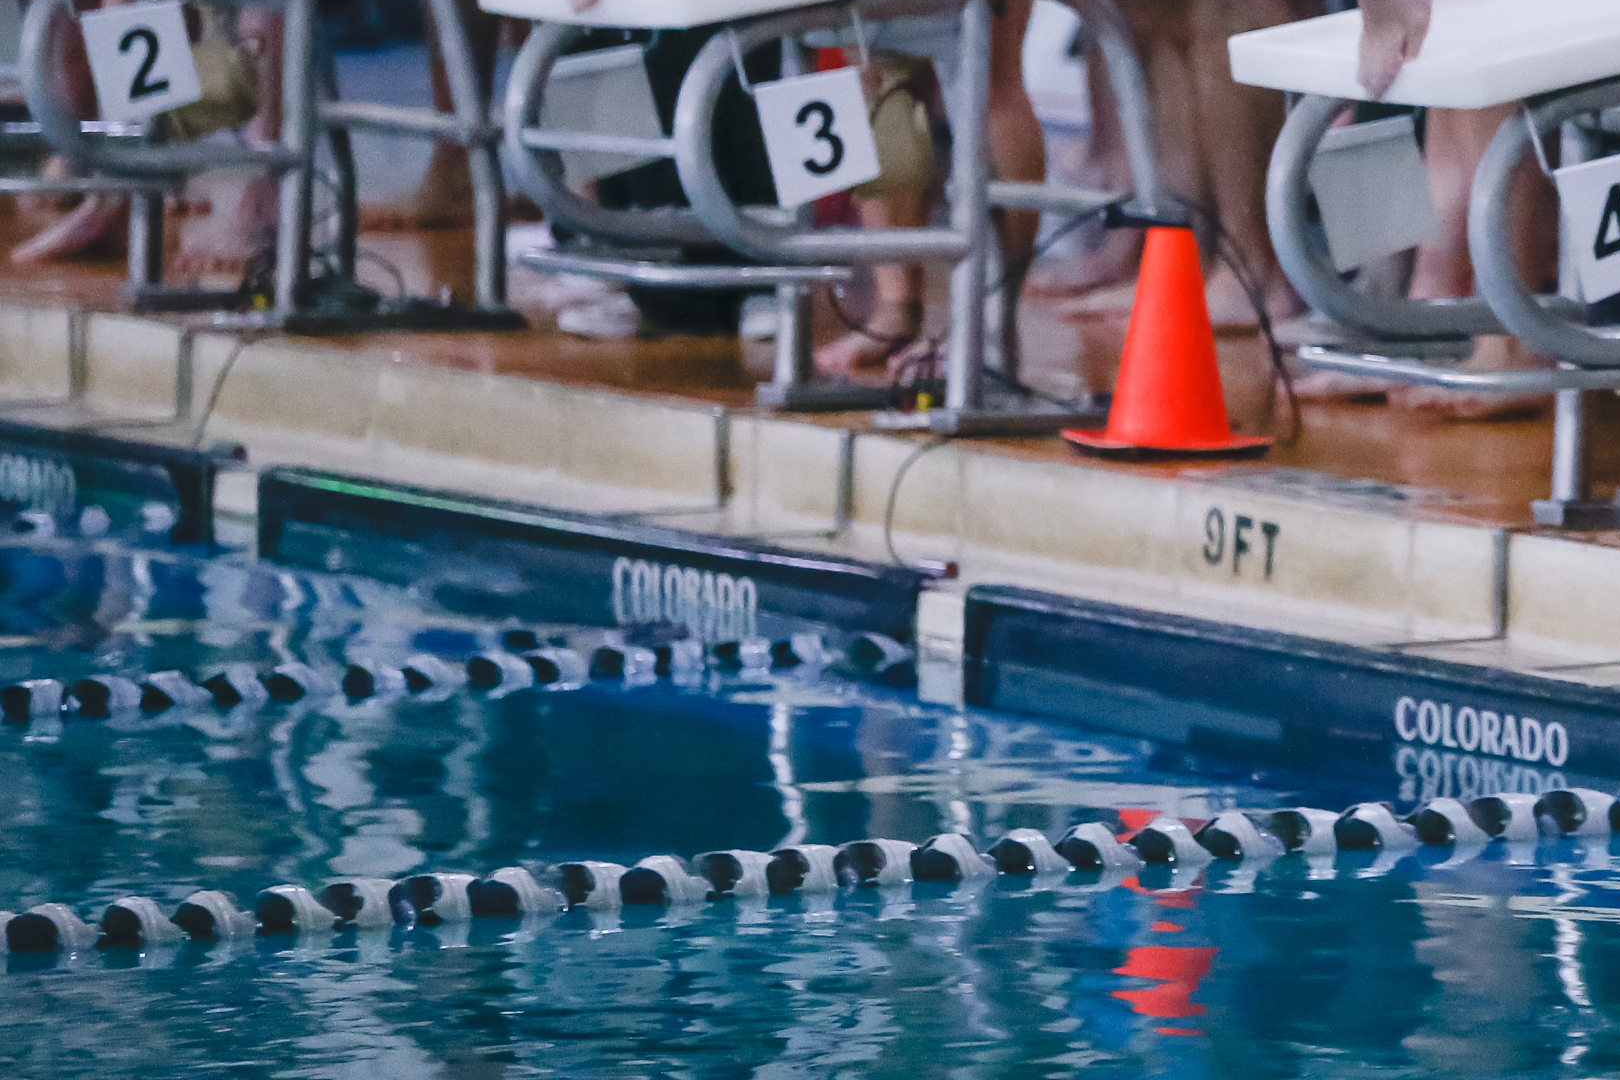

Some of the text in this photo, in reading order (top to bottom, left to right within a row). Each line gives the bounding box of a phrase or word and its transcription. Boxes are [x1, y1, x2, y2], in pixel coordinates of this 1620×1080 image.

[119, 28, 169, 100] 2
[796, 101, 844, 174] 3
[1395, 696, 1568, 767] COLORADO
